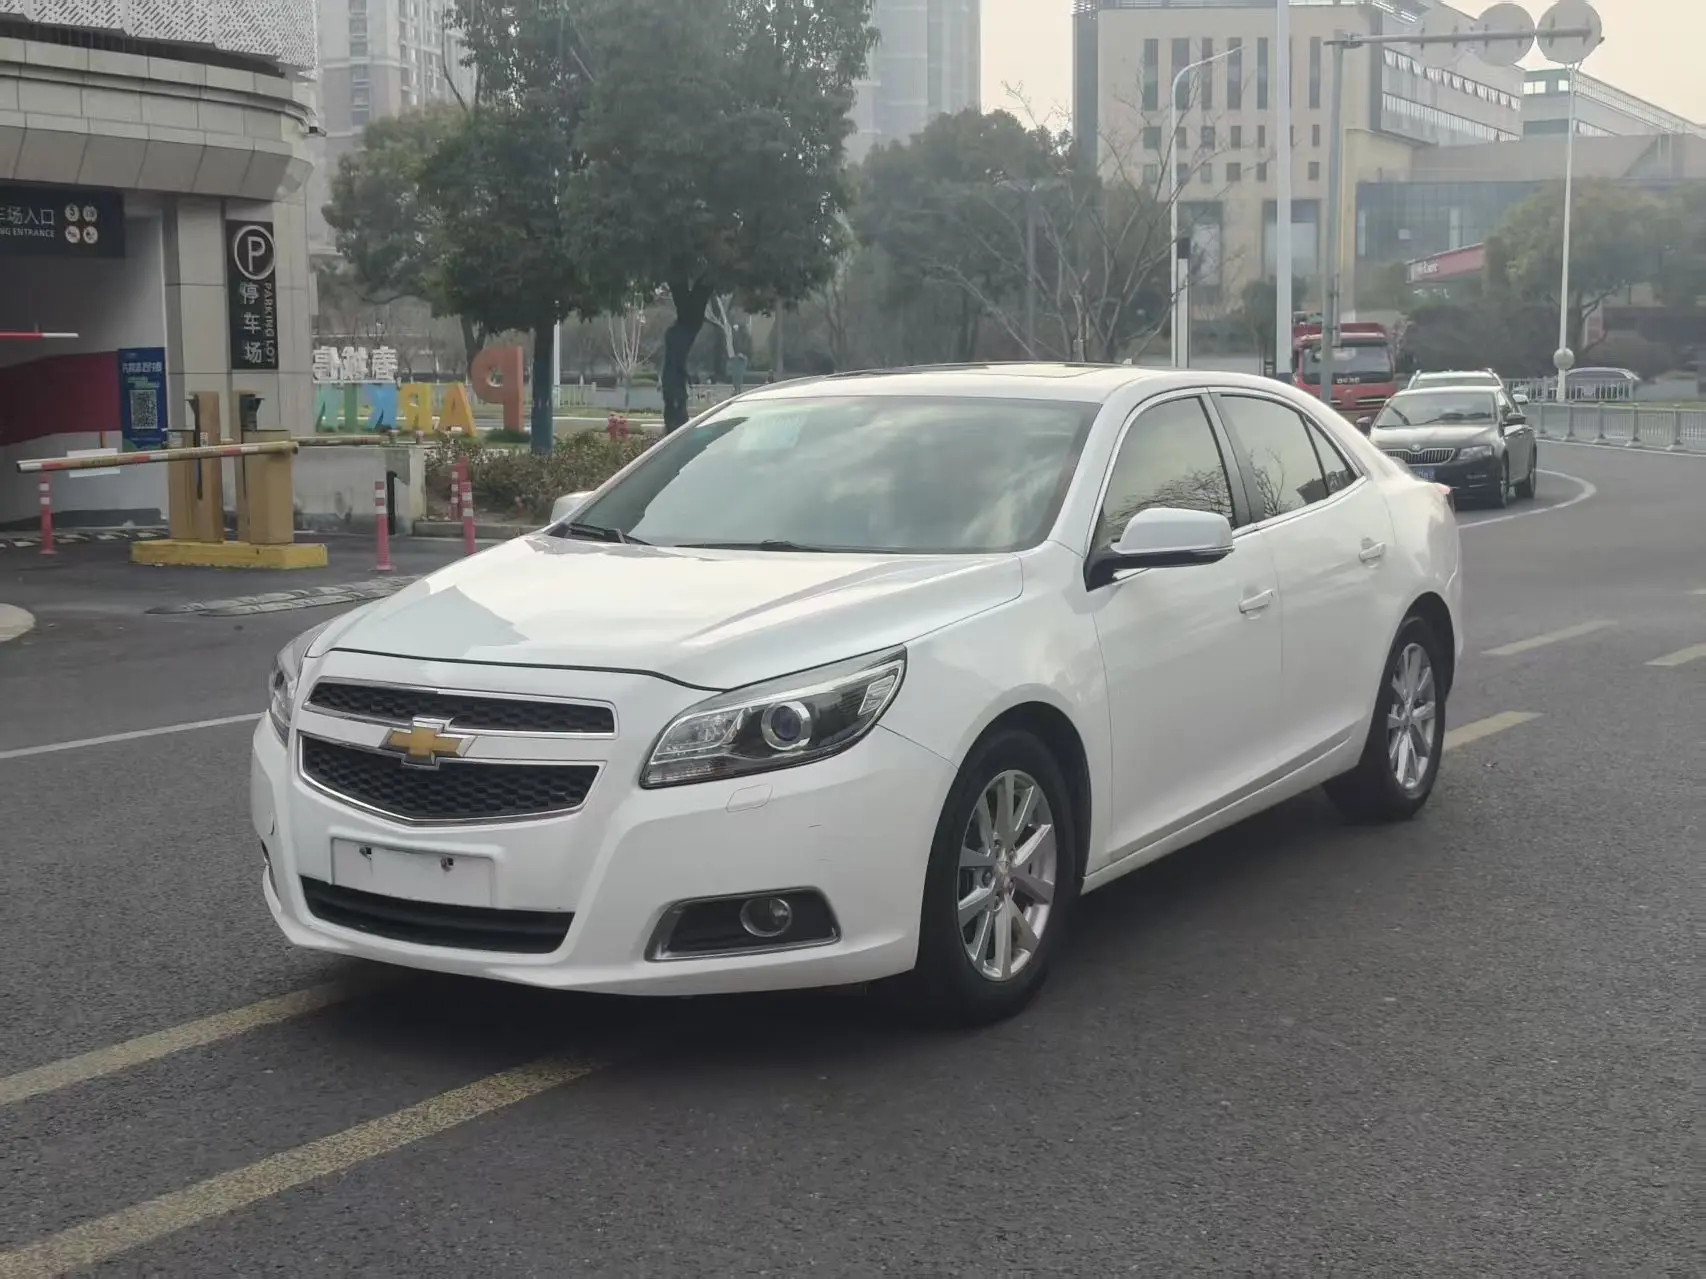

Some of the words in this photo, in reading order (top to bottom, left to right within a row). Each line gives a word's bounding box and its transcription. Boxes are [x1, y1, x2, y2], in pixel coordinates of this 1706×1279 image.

[13, 228, 56, 239] ENTRANCE
[247, 235, 266, 273] P
[239, 281, 263, 365] 停车场
[263, 282, 275, 337] PARKING
[265, 339, 275, 365] LOT
